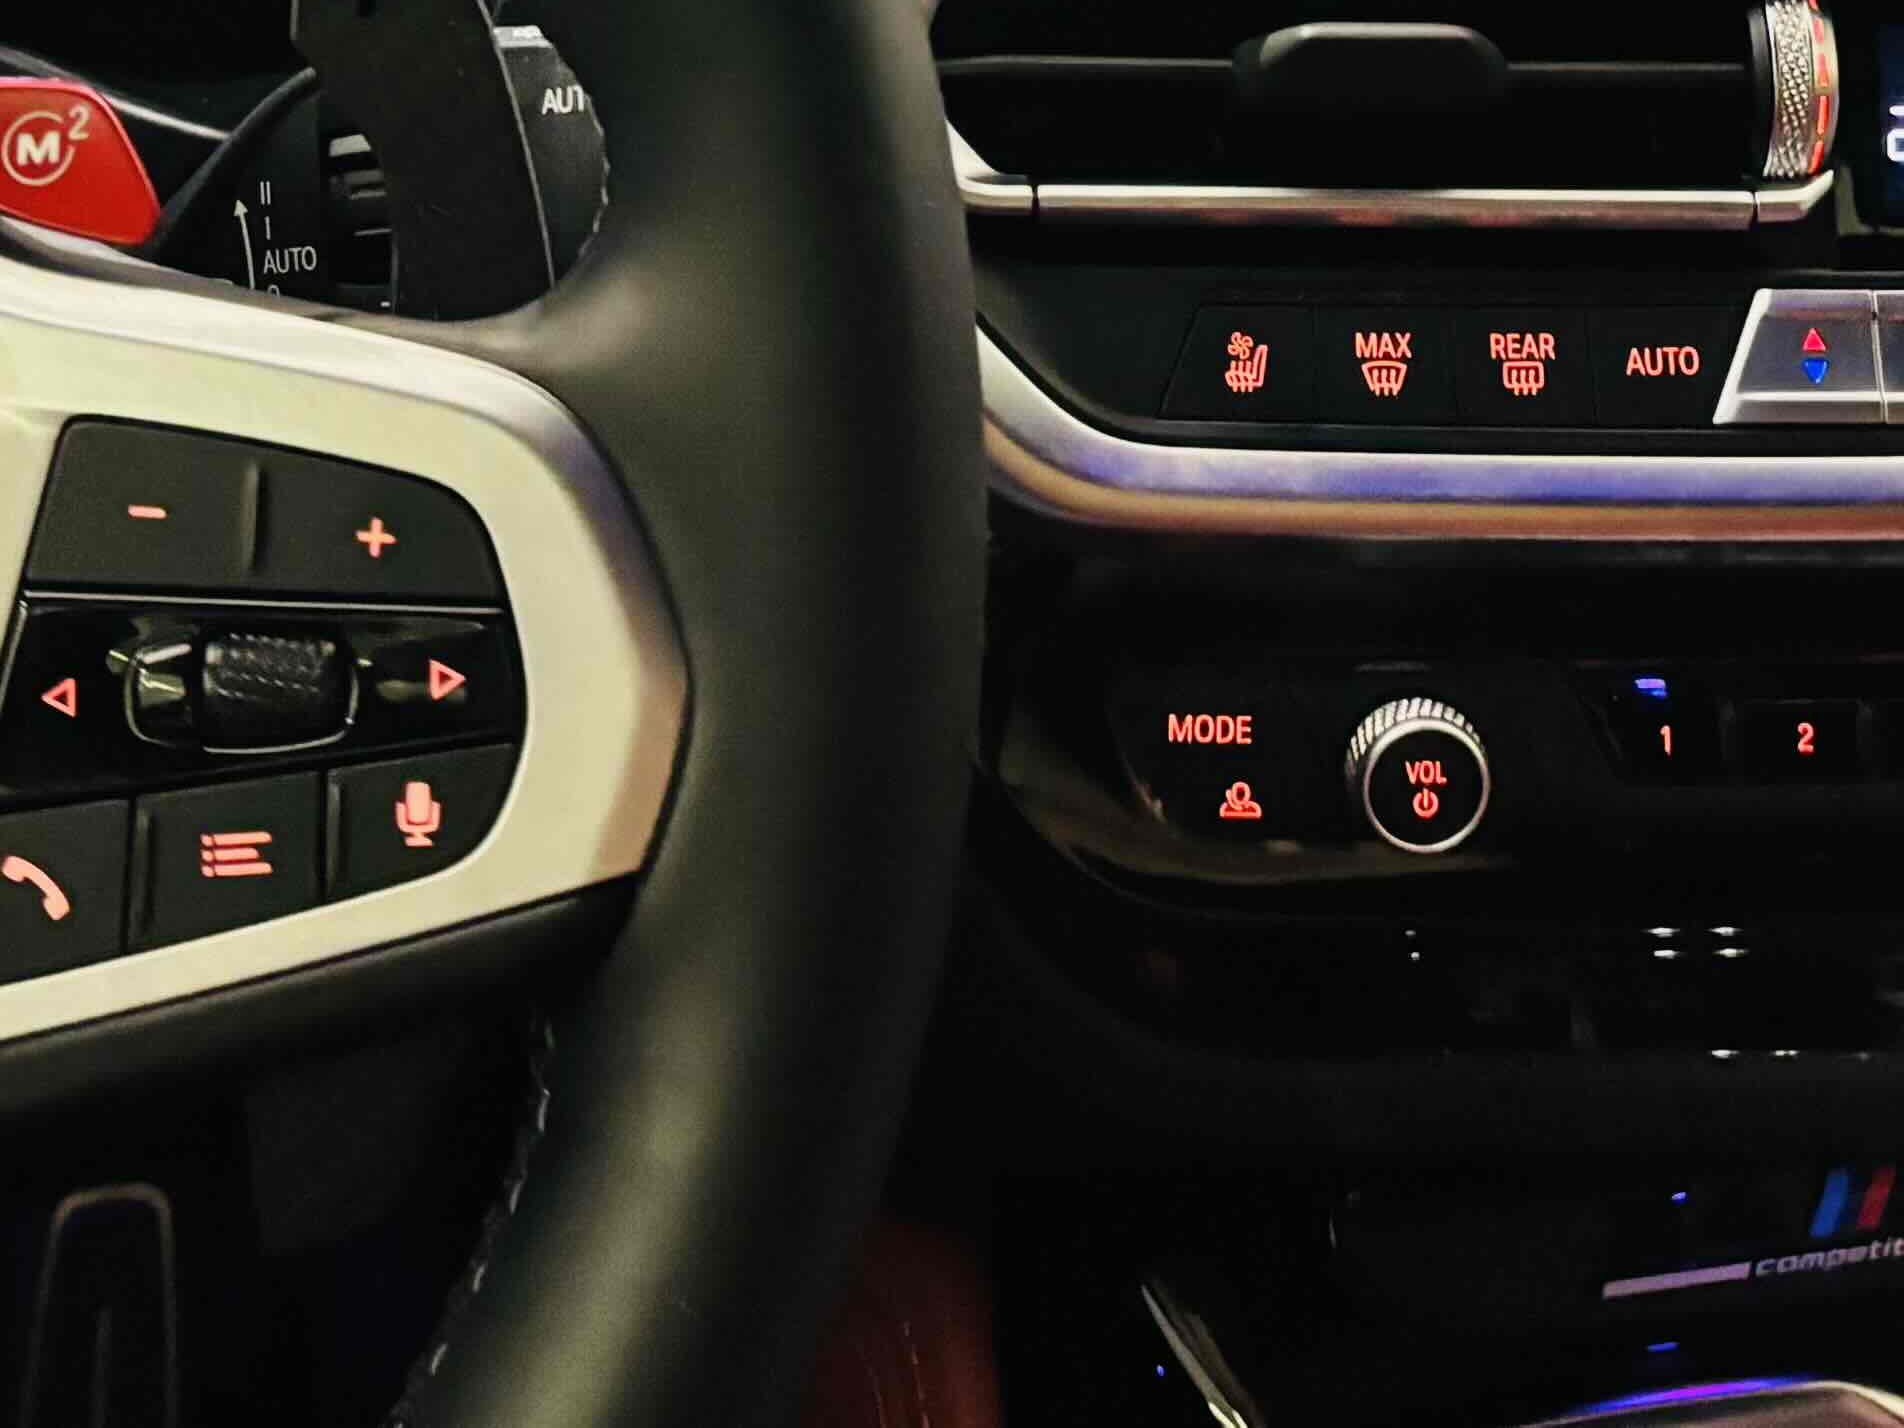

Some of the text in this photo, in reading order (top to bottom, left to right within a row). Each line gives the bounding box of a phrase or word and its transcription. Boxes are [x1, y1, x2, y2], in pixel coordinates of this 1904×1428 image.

[541, 85, 586, 115] AUT
[263, 246, 317, 274] AUTO
[1355, 333, 1412, 359] MAX
[1490, 333, 1555, 360] REAR
[1626, 346, 1700, 377] AUTO
[1167, 715, 1253, 744] MODE
[1659, 724, 1673, 755] 1
[1796, 722, 1816, 755] 2
[1406, 760, 1447, 786] VOL
